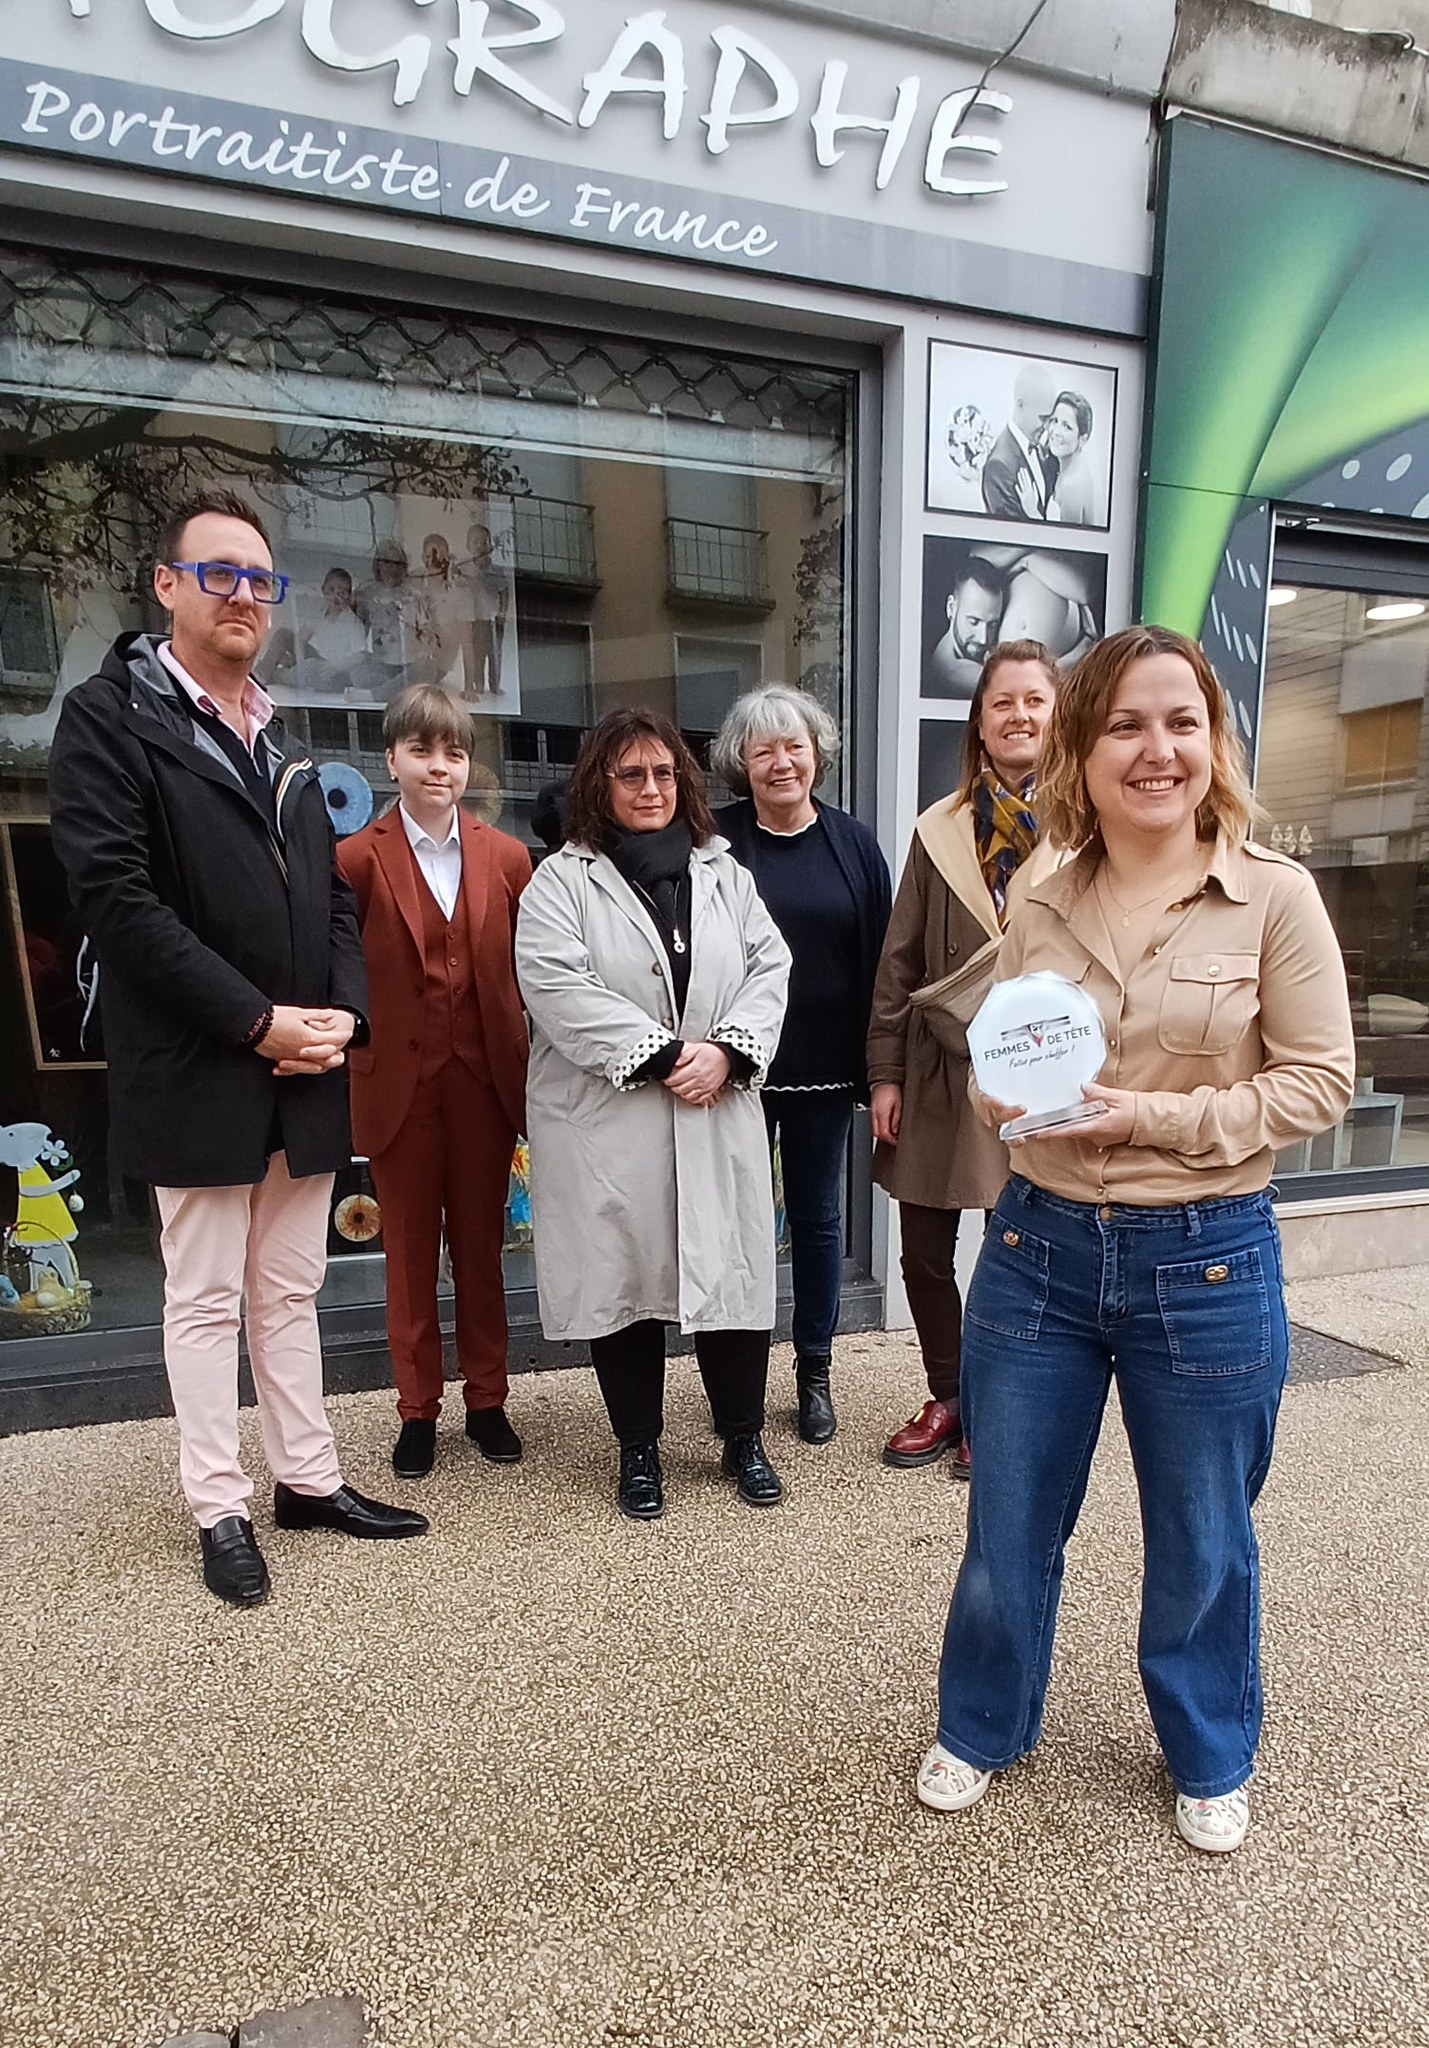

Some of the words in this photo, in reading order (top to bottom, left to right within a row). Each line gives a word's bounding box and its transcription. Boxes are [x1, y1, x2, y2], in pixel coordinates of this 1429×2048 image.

[22, 81, 441, 200] Portraitiste
[464, 156, 551, 214] de
[570, 181, 779, 258] France
[984, 1041, 1031, 1061] FEMMES
[1047, 1033, 1062, 1045] DE
[1063, 1026, 1092, 1041] TÊTE
